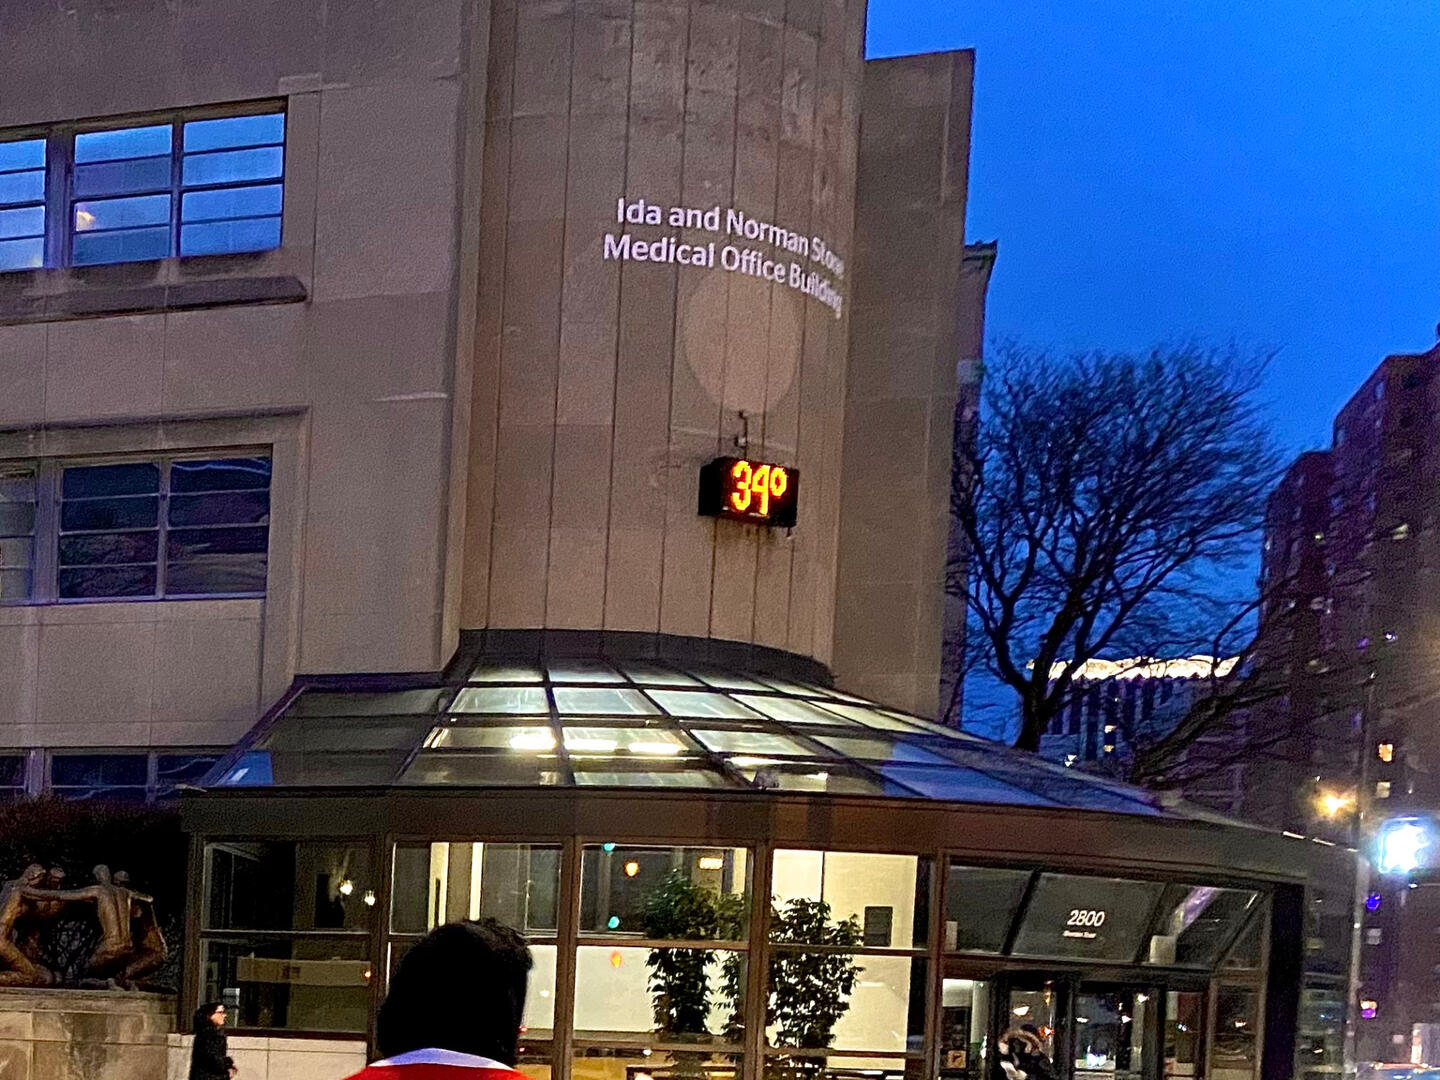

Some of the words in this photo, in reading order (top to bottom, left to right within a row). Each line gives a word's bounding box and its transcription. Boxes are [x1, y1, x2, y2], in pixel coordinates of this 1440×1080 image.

[617, 197, 661, 224] Ida
[668, 206, 720, 231] and
[726, 208, 809, 256] Norman
[603, 233, 715, 268] Medical
[721, 245, 786, 283] Office
[1067, 909, 1106, 927] 2800
